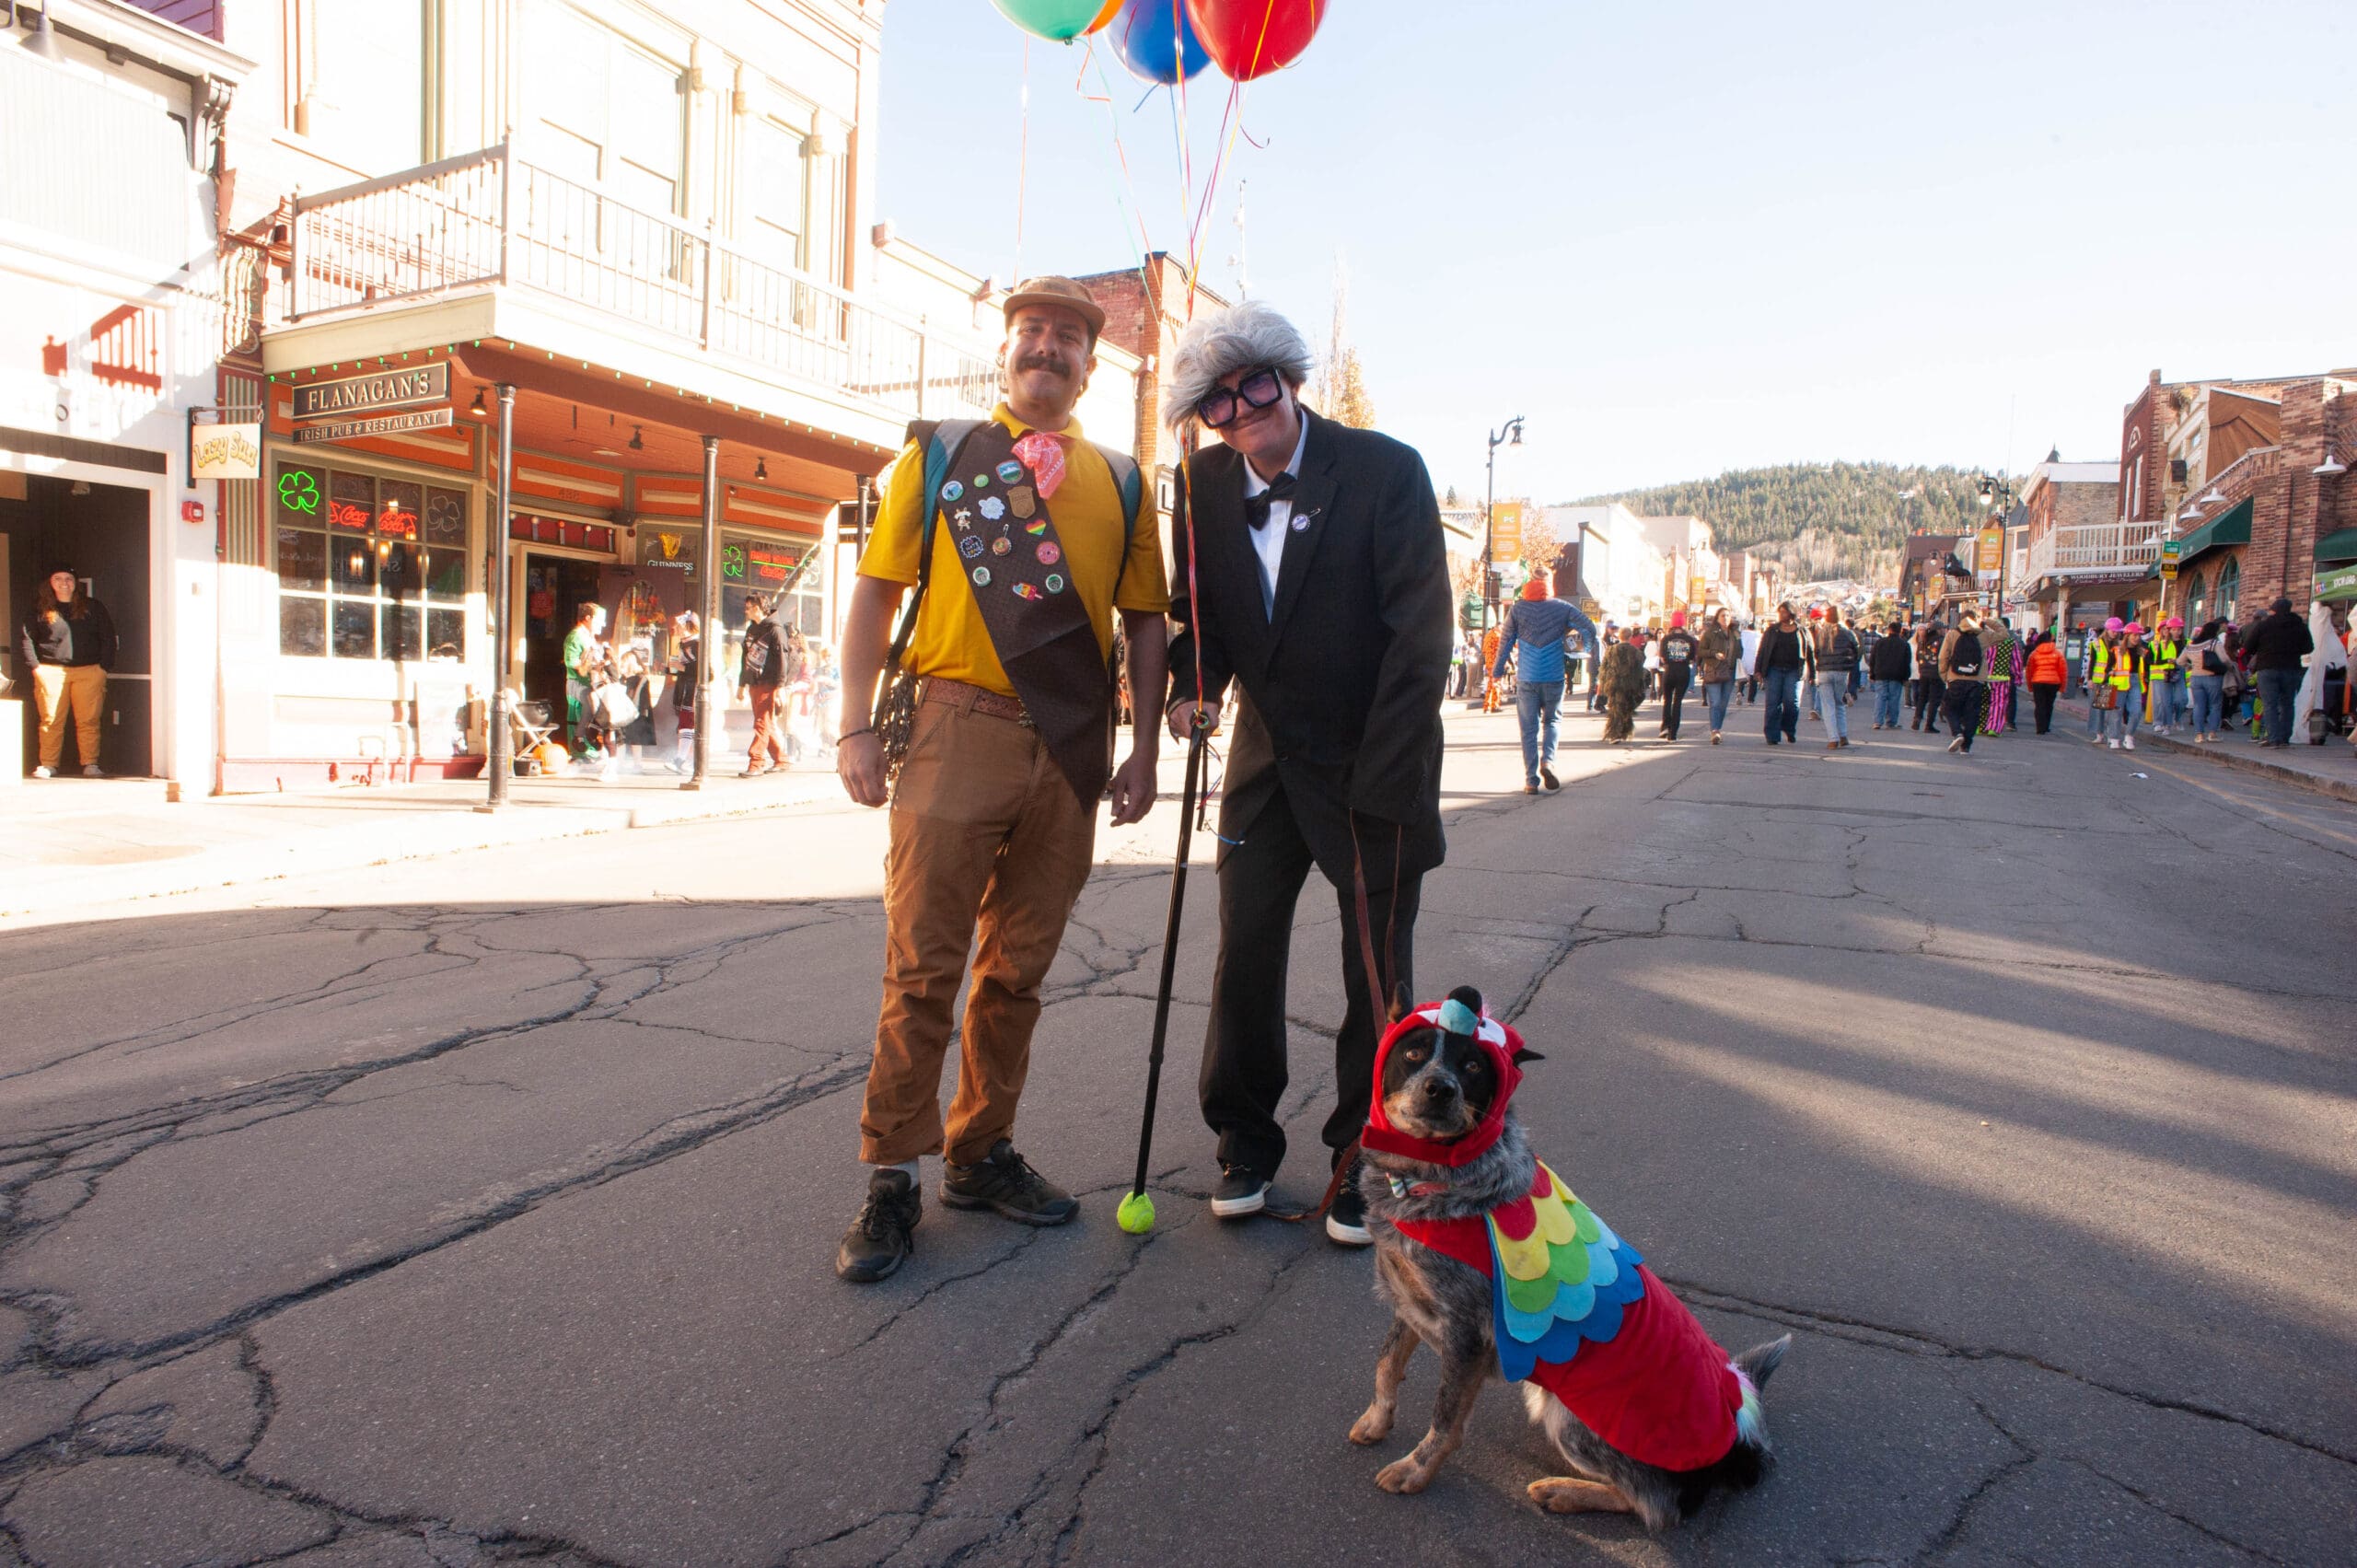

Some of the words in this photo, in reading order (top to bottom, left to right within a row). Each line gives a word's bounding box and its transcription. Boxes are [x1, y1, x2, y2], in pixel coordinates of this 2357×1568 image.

[308, 372, 430, 411] FLANAGAN'S
[299, 429, 328, 441] IRISH
[331, 424, 352, 437] PUB
[364, 412, 439, 433] RESTAURANT
[193, 436, 228, 469] Lazy
[647, 559, 694, 571] GUINNESS
